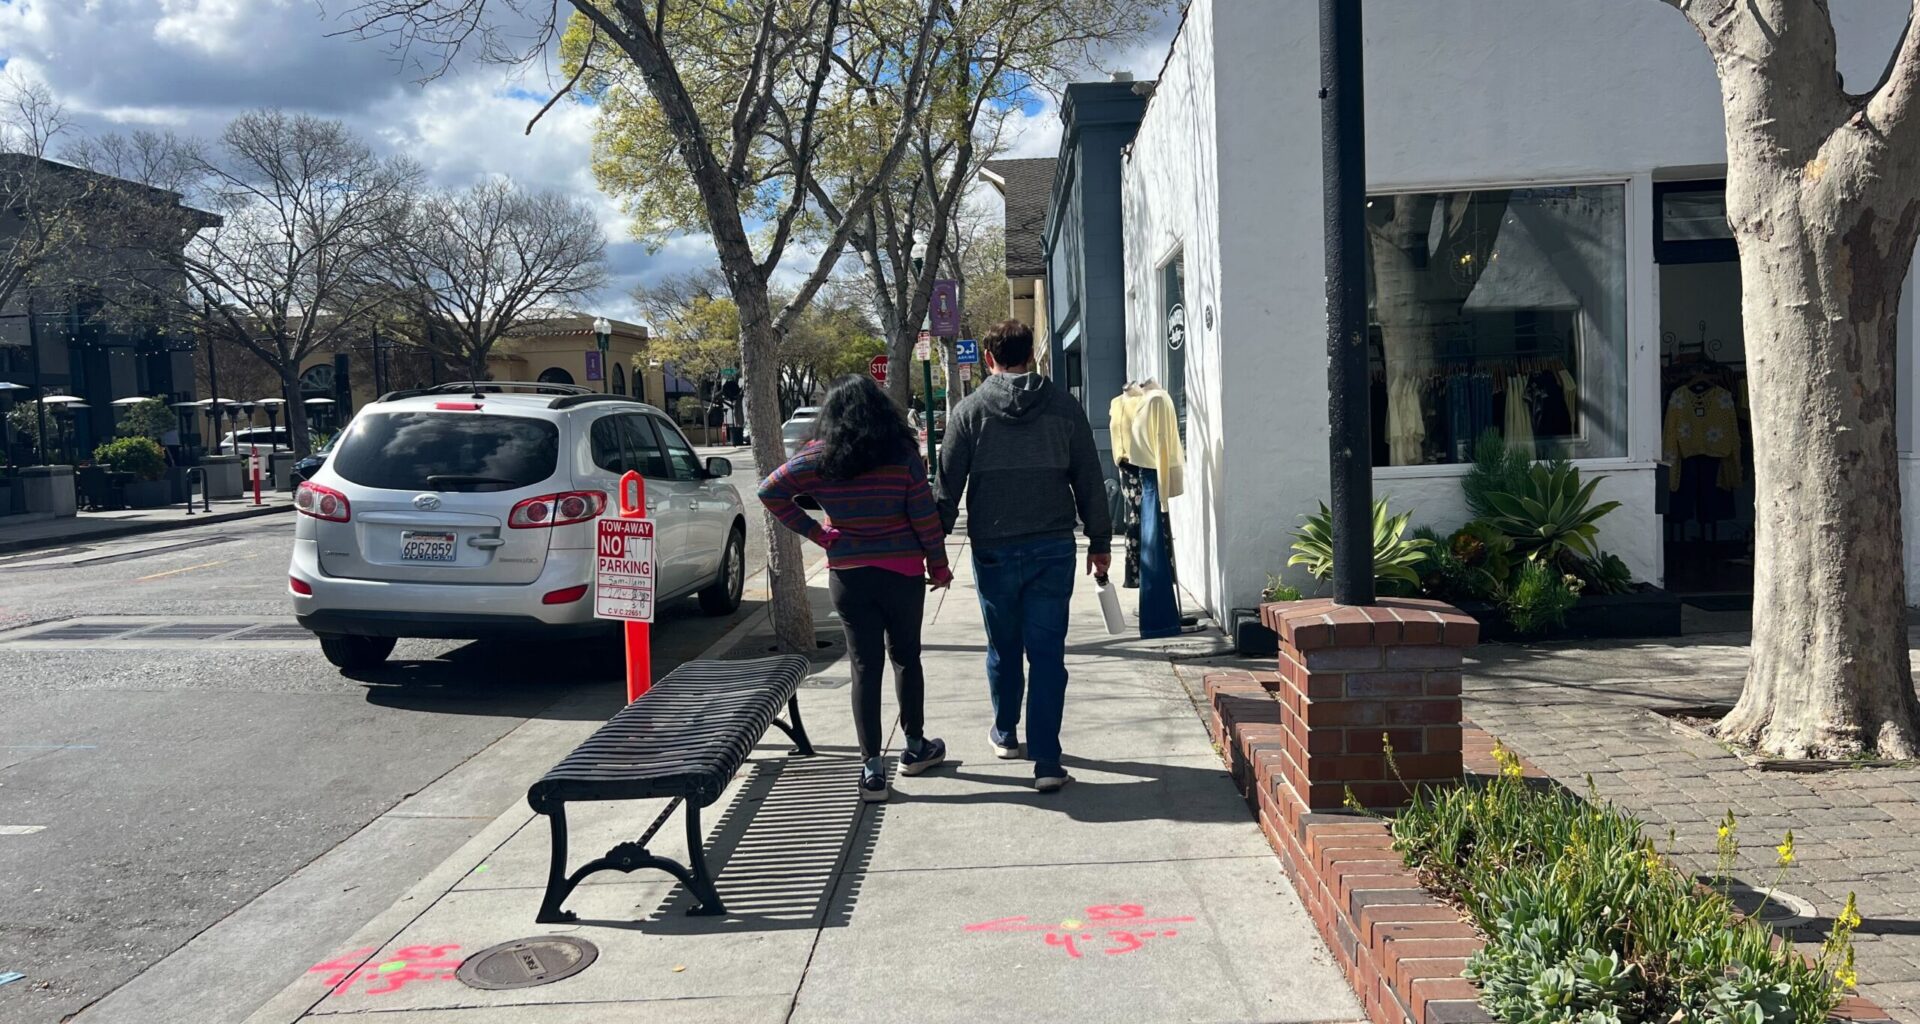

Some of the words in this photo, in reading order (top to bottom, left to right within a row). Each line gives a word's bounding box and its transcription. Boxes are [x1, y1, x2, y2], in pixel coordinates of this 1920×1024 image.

[871, 363, 888, 374] STO
[601, 521, 650, 534] TOW-AWAY
[404, 542, 452, 556] 6PGZ859
[601, 535, 621, 555] NO
[600, 558, 650, 575] PARKING
